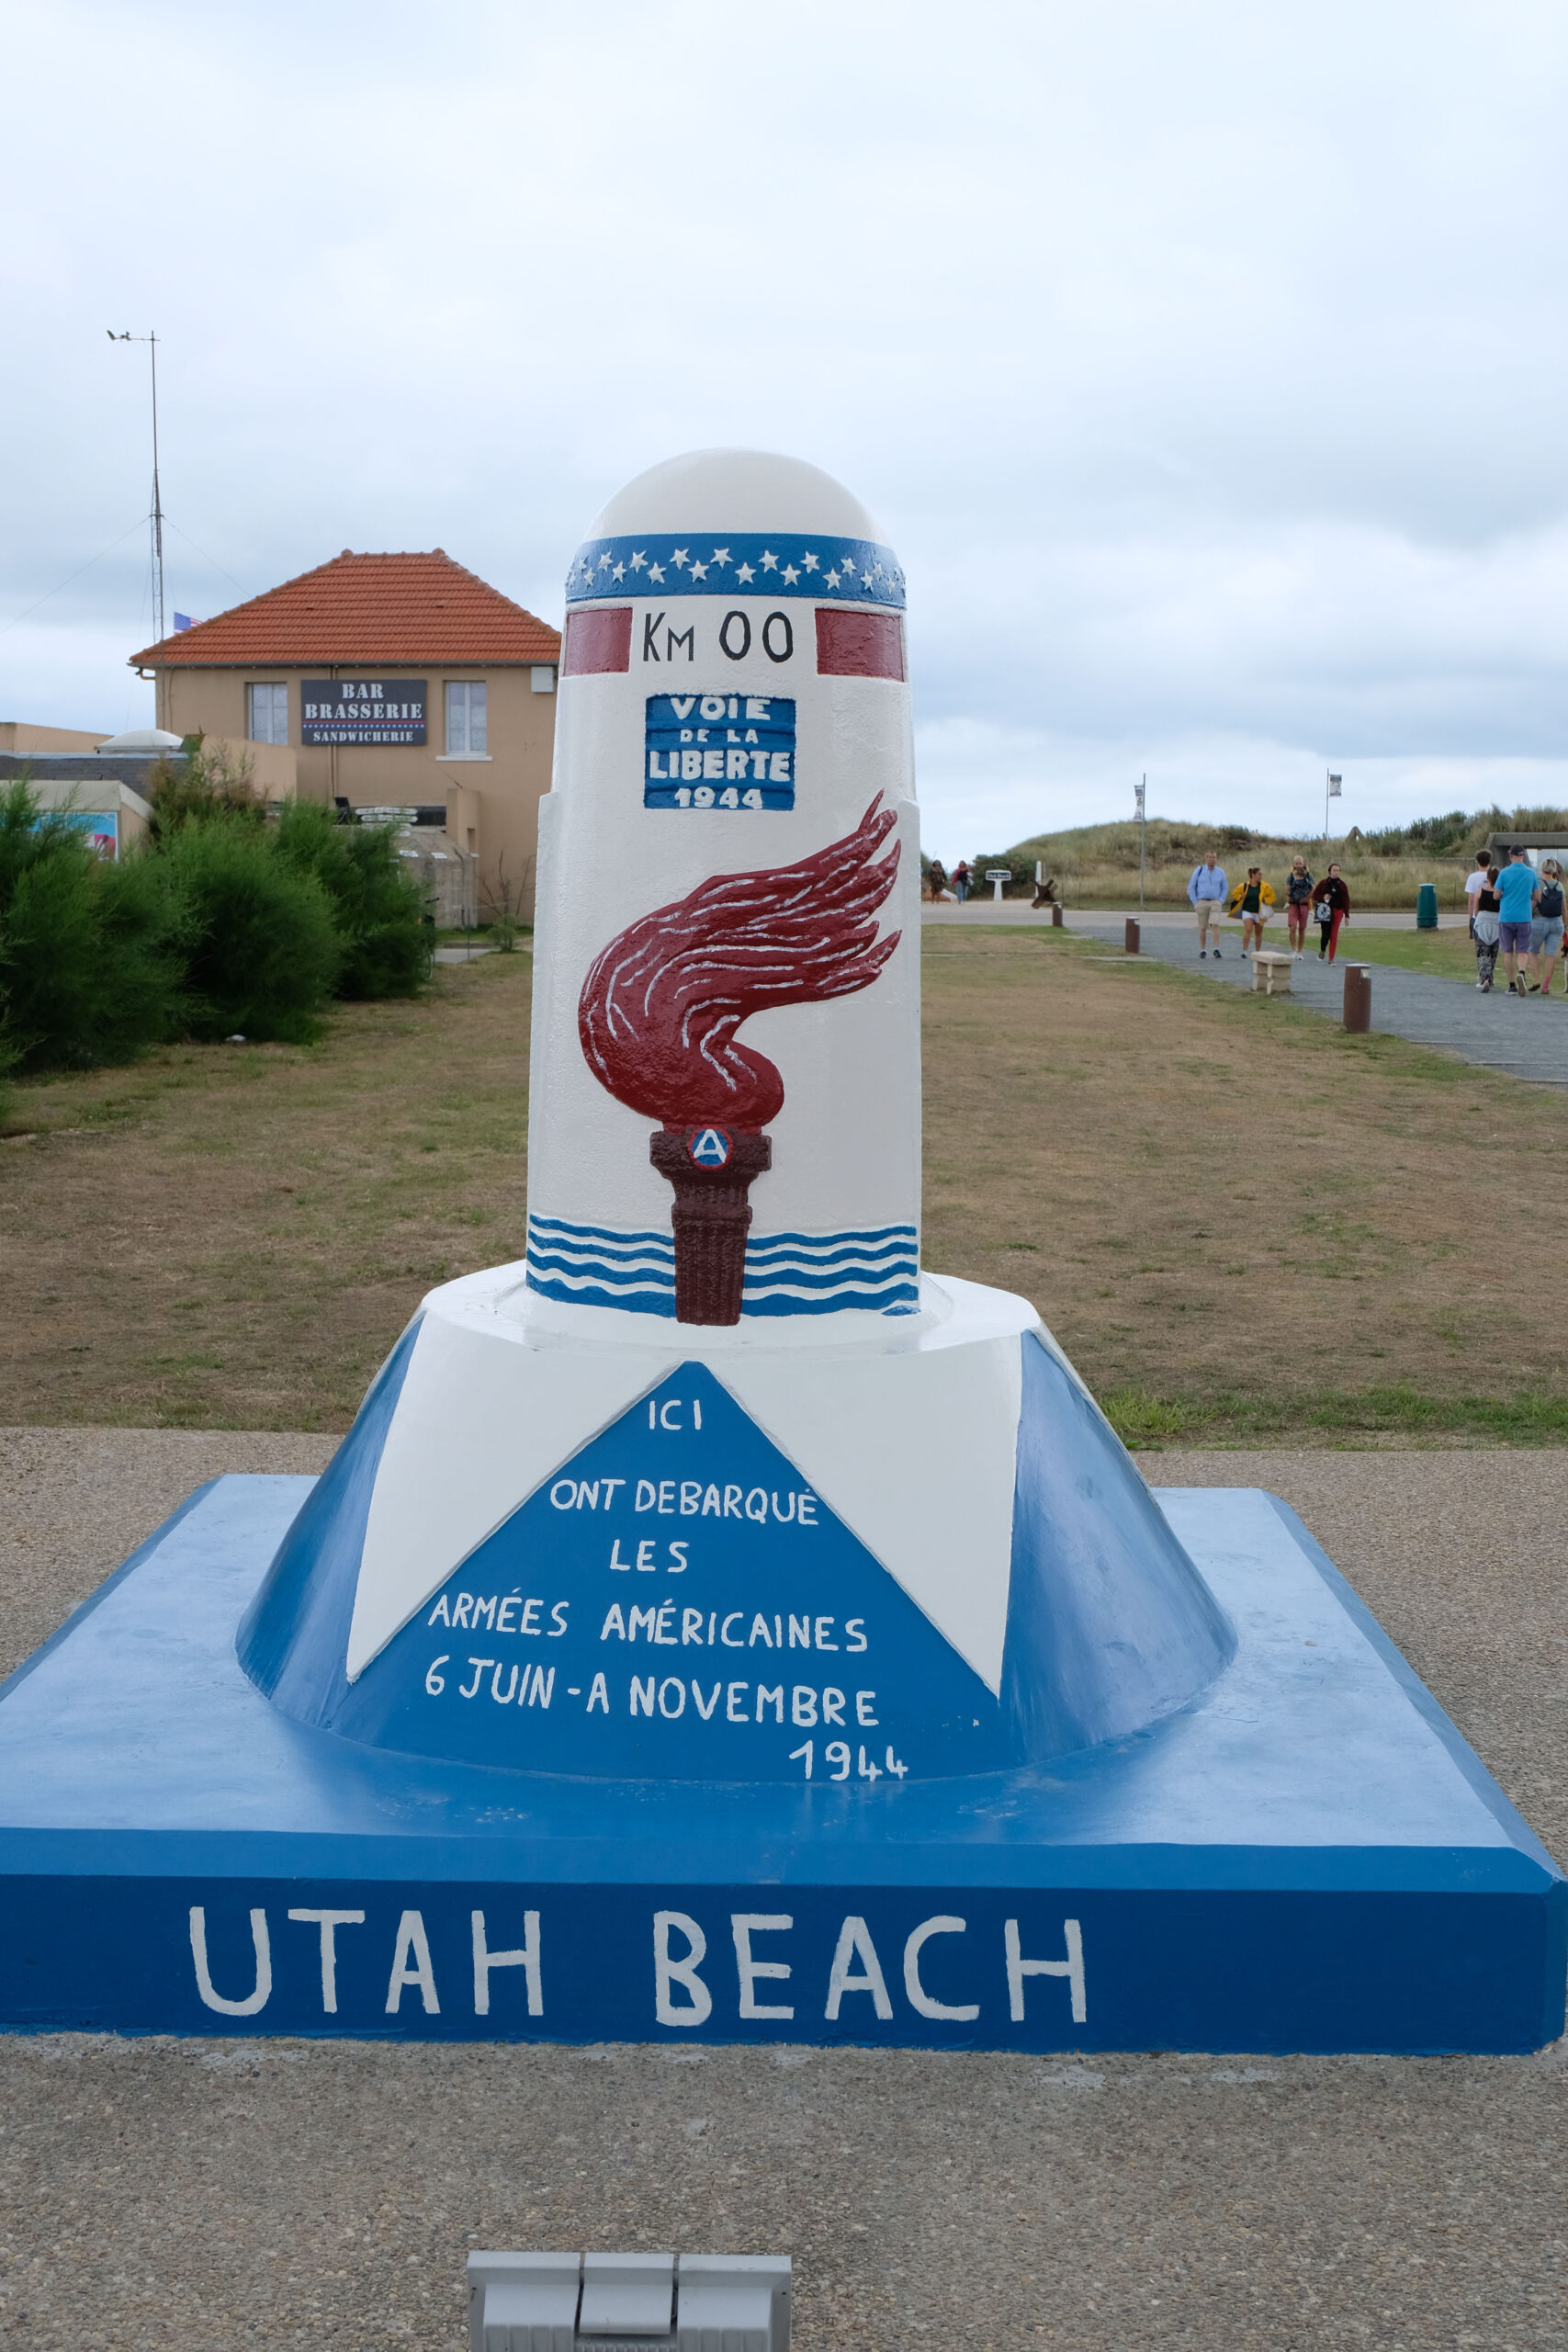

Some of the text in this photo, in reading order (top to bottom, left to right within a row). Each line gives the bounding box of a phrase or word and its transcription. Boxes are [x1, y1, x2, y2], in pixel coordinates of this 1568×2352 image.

[342, 684, 384, 699] BAR
[305, 704, 423, 719] BRASSERIE
[670, 696, 771, 721] VOIE
[313, 731, 414, 742] SANDWICHERIE
[680, 729, 759, 743] DE LA
[649, 751, 792, 782] LIBERTE
[674, 786, 763, 810] 1944
[694, 1128, 728, 1163] A
[649, 1400, 703, 1431] ICI
[549, 1478, 820, 1525] ONT DEBARQUÉ
[610, 1539, 690, 1573] LES
[427, 1588, 868, 1653] ARMÉES AMÉRICAINES
[424, 1655, 446, 1697] 6
[459, 1657, 555, 1709] JUIN
[629, 1675, 879, 1727] NOVEMBRE
[788, 1739, 909, 1782] 1944
[188, 1905, 1087, 2028] UTAH BEACH
